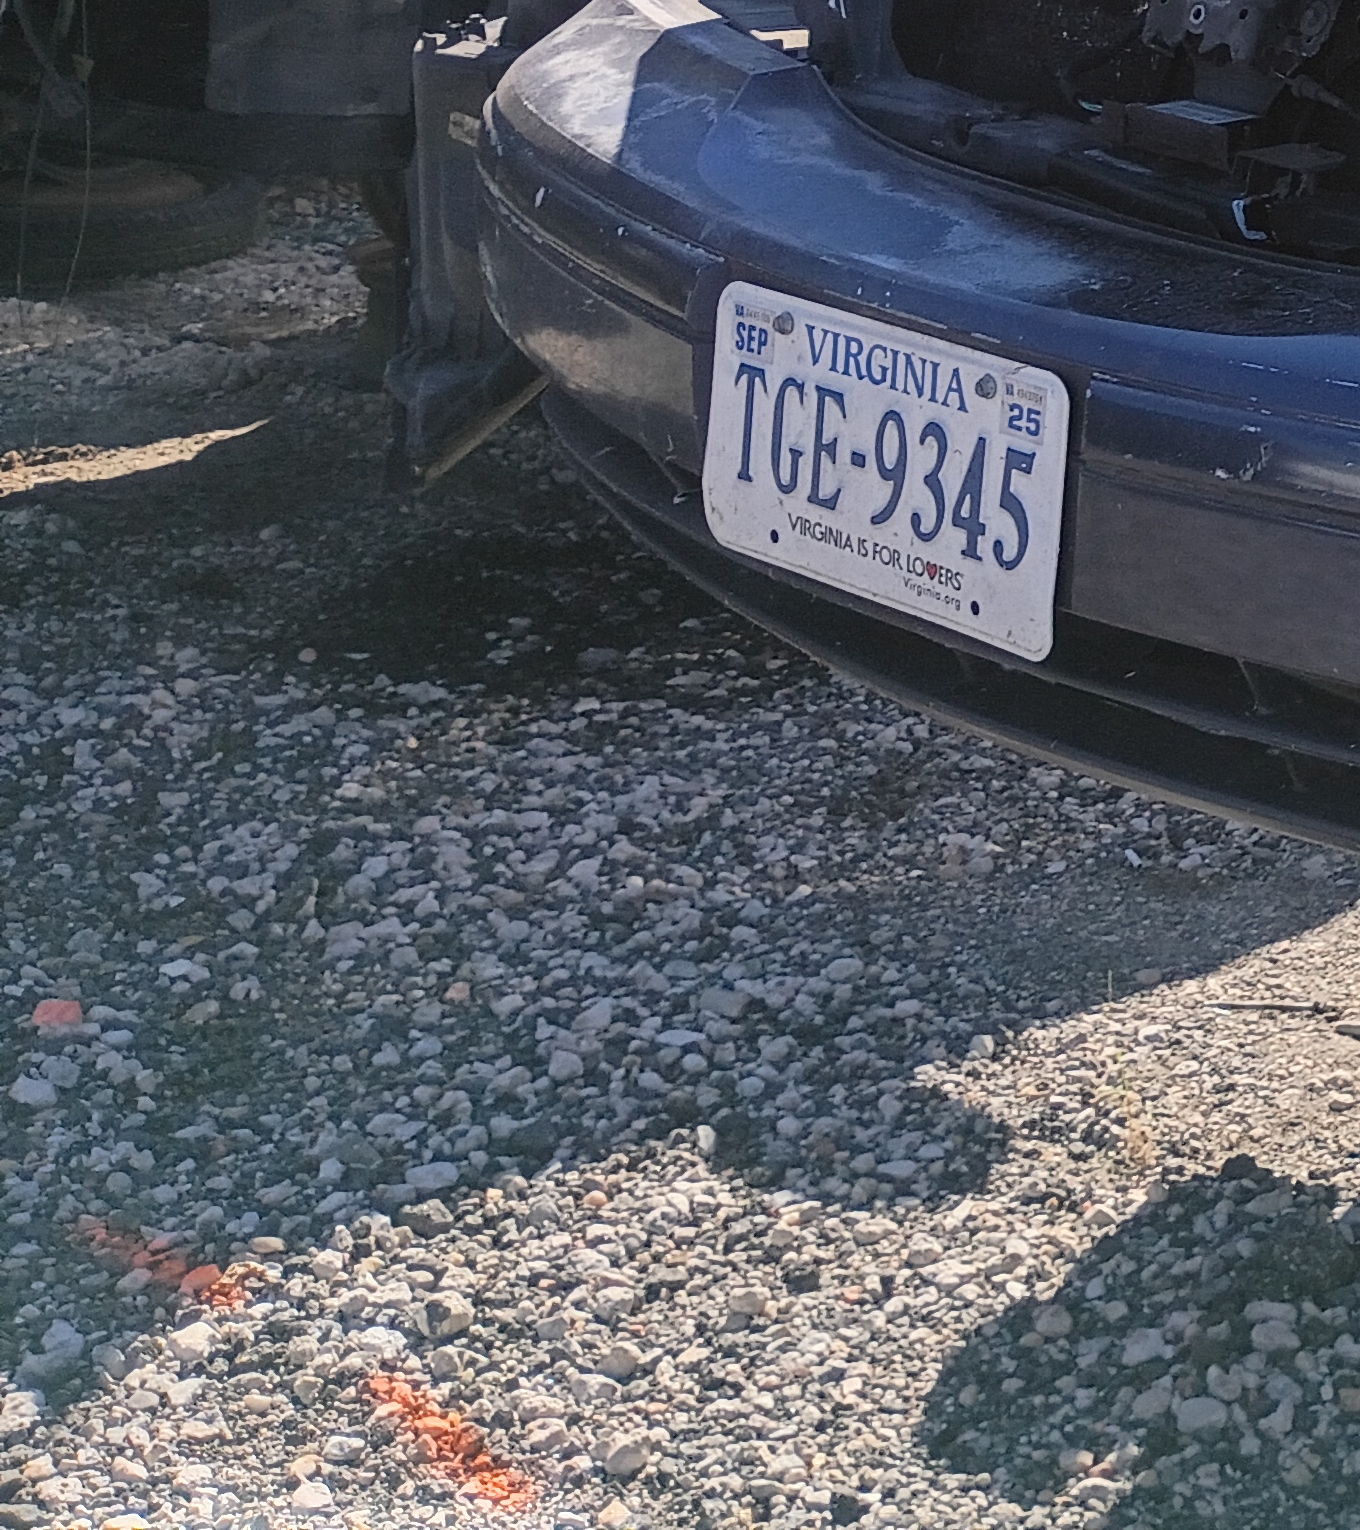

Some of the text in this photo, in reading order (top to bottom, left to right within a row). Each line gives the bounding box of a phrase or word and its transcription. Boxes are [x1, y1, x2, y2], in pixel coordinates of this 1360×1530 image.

[735, 322, 768, 355] SEP
[805, 323, 968, 413] VIRGINIA
[1008, 402, 1041, 436] 25
[735, 362, 1036, 571] TGE-9345
[787, 512, 854, 553] VIRGINIA
[857, 537, 869, 557] IS
[872, 542, 903, 571] FOR
[903, 576, 961, 611] Virginia.org
